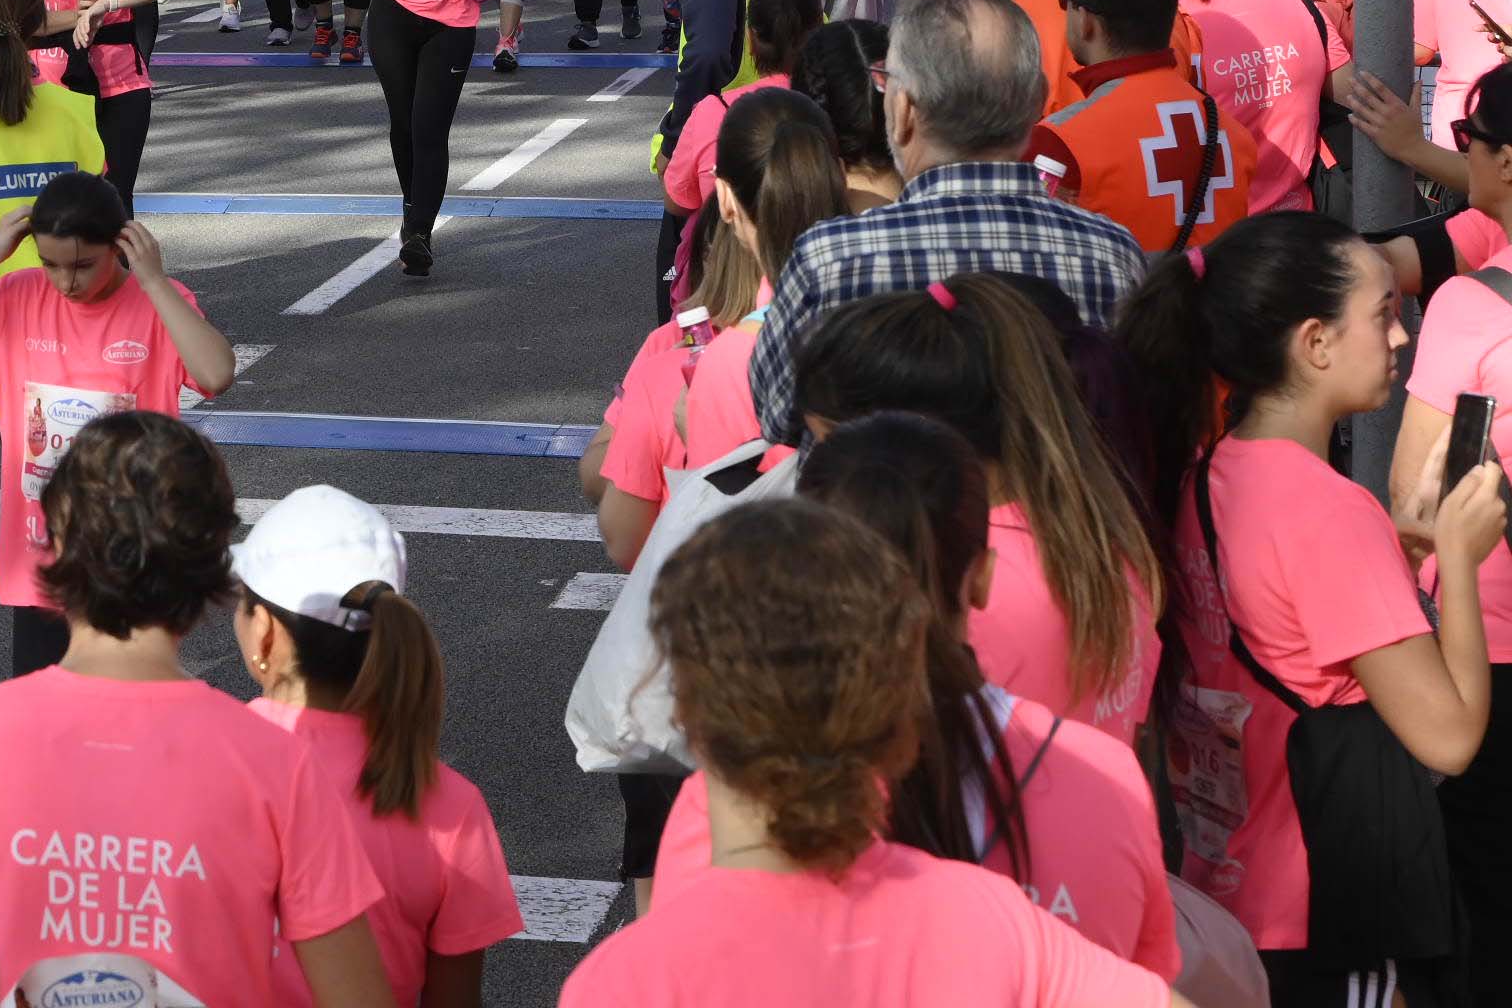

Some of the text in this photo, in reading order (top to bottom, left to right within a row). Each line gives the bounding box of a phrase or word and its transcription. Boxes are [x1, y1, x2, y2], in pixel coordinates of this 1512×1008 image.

[1213, 42, 1299, 76] CARRERA
[1235, 63, 1288, 89] DE LA
[1234, 79, 1292, 107] MUJER
[11, 828, 206, 880] CARRERA
[48, 869, 166, 914] DE LA
[40, 905, 173, 953] MUJER
[51, 989, 137, 1008] ASTURIANA
